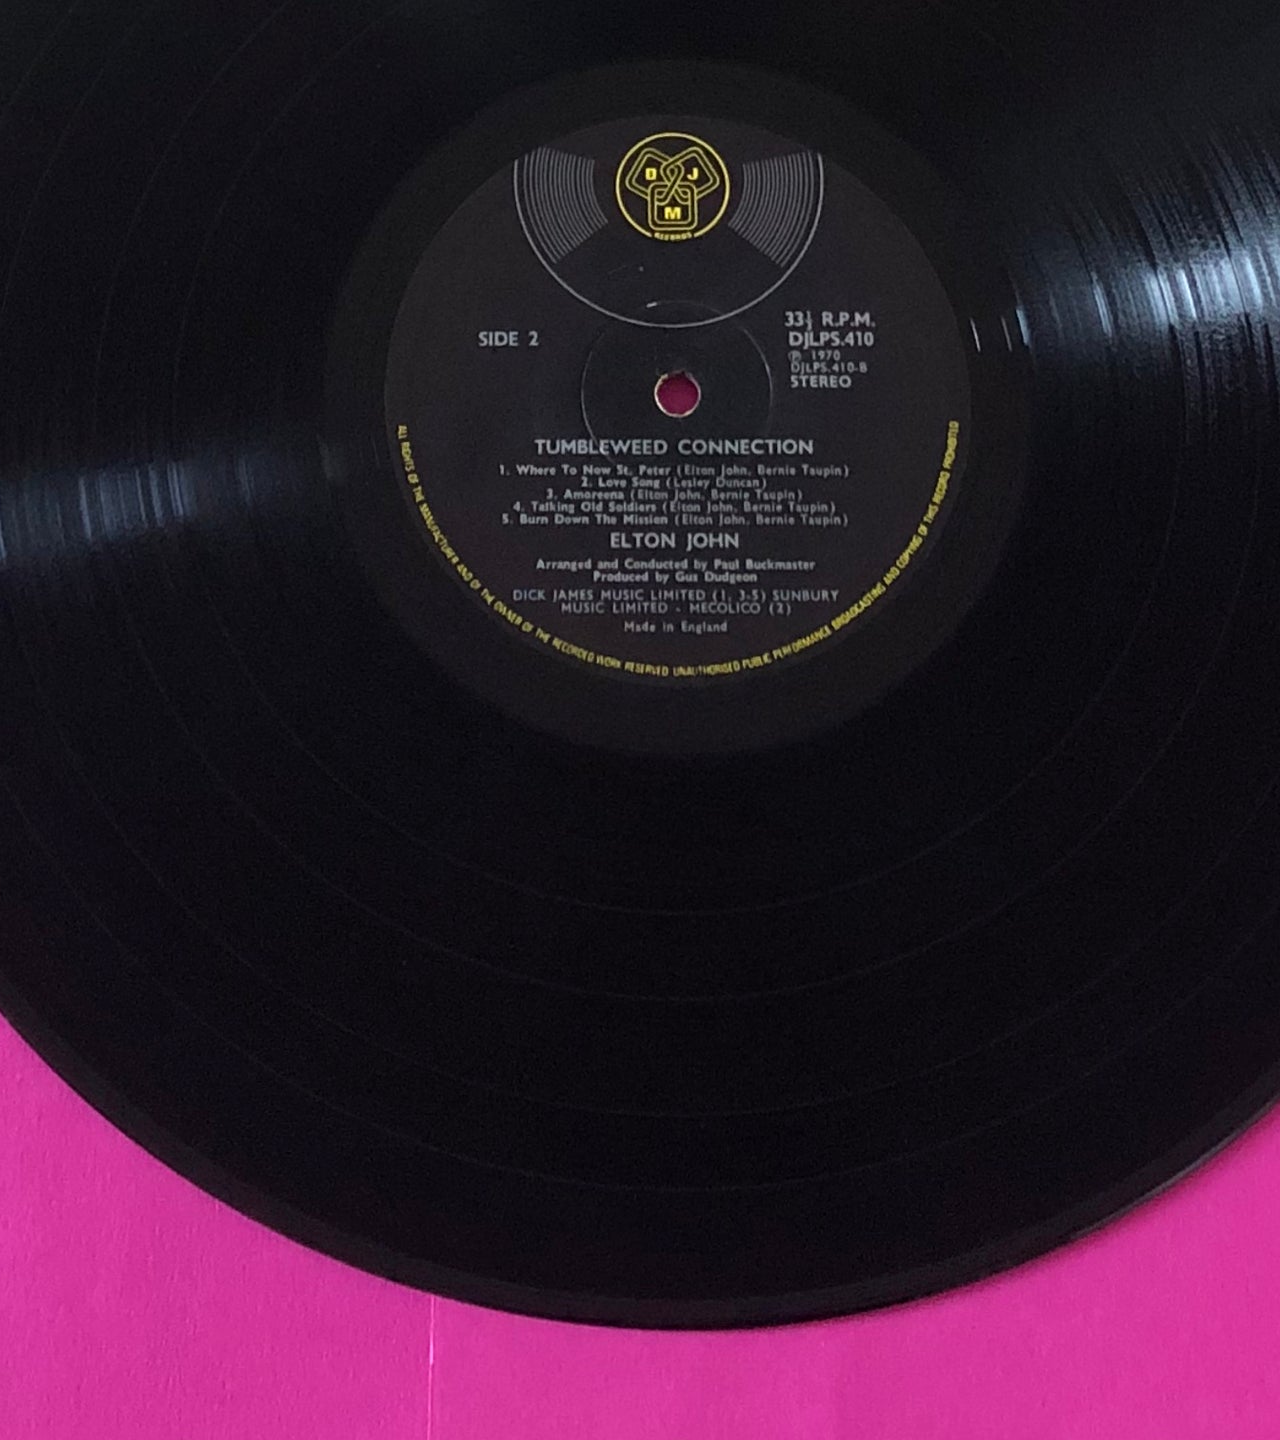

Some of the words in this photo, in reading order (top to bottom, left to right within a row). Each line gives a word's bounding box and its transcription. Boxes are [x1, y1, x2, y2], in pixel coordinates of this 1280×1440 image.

[664, 207, 682, 220] M
[821, 310, 877, 328] R.P.M.
[477, 330, 520, 347] SIDE
[527, 329, 540, 347] 2
[788, 331, 875, 350] DJLPS.410
[810, 350, 842, 363] 1970
[789, 375, 853, 389] STEREO
[533, 439, 669, 458] TUMBLEWEED
[677, 438, 814, 456] CONNECTION
[519, 513, 550, 526] Burn
[553, 513, 590, 526] Down
[594, 513, 618, 526] The
[622, 513, 669, 526] Mission
[755, 513, 796, 526] Bernie
[799, 513, 849, 528] Taupin)
[609, 531, 677, 549] ELTON
[685, 531, 740, 552] JOHN
[535, 559, 592, 573] Arranged
[597, 558, 620, 571] and
[623, 558, 689, 571] Conducted
[693, 558, 709, 573] by
[714, 558, 740, 571] Paul
[745, 558, 816, 571] Buckmaster
[592, 570, 650, 583] Produced
[654, 570, 671, 585] by
[674, 570, 699, 583] Gus
[701, 570, 758, 585] Dudgeon
[512, 588, 548, 602] DICK
[553, 588, 594, 604] JAMES
[600, 588, 644, 602] MUSIC
[650, 588, 708, 602] LIMITED
[772, 588, 840, 602] SUNBURY
[623, 620, 657, 633] Made
[662, 620, 675, 633] in
[680, 619, 728, 635] England
